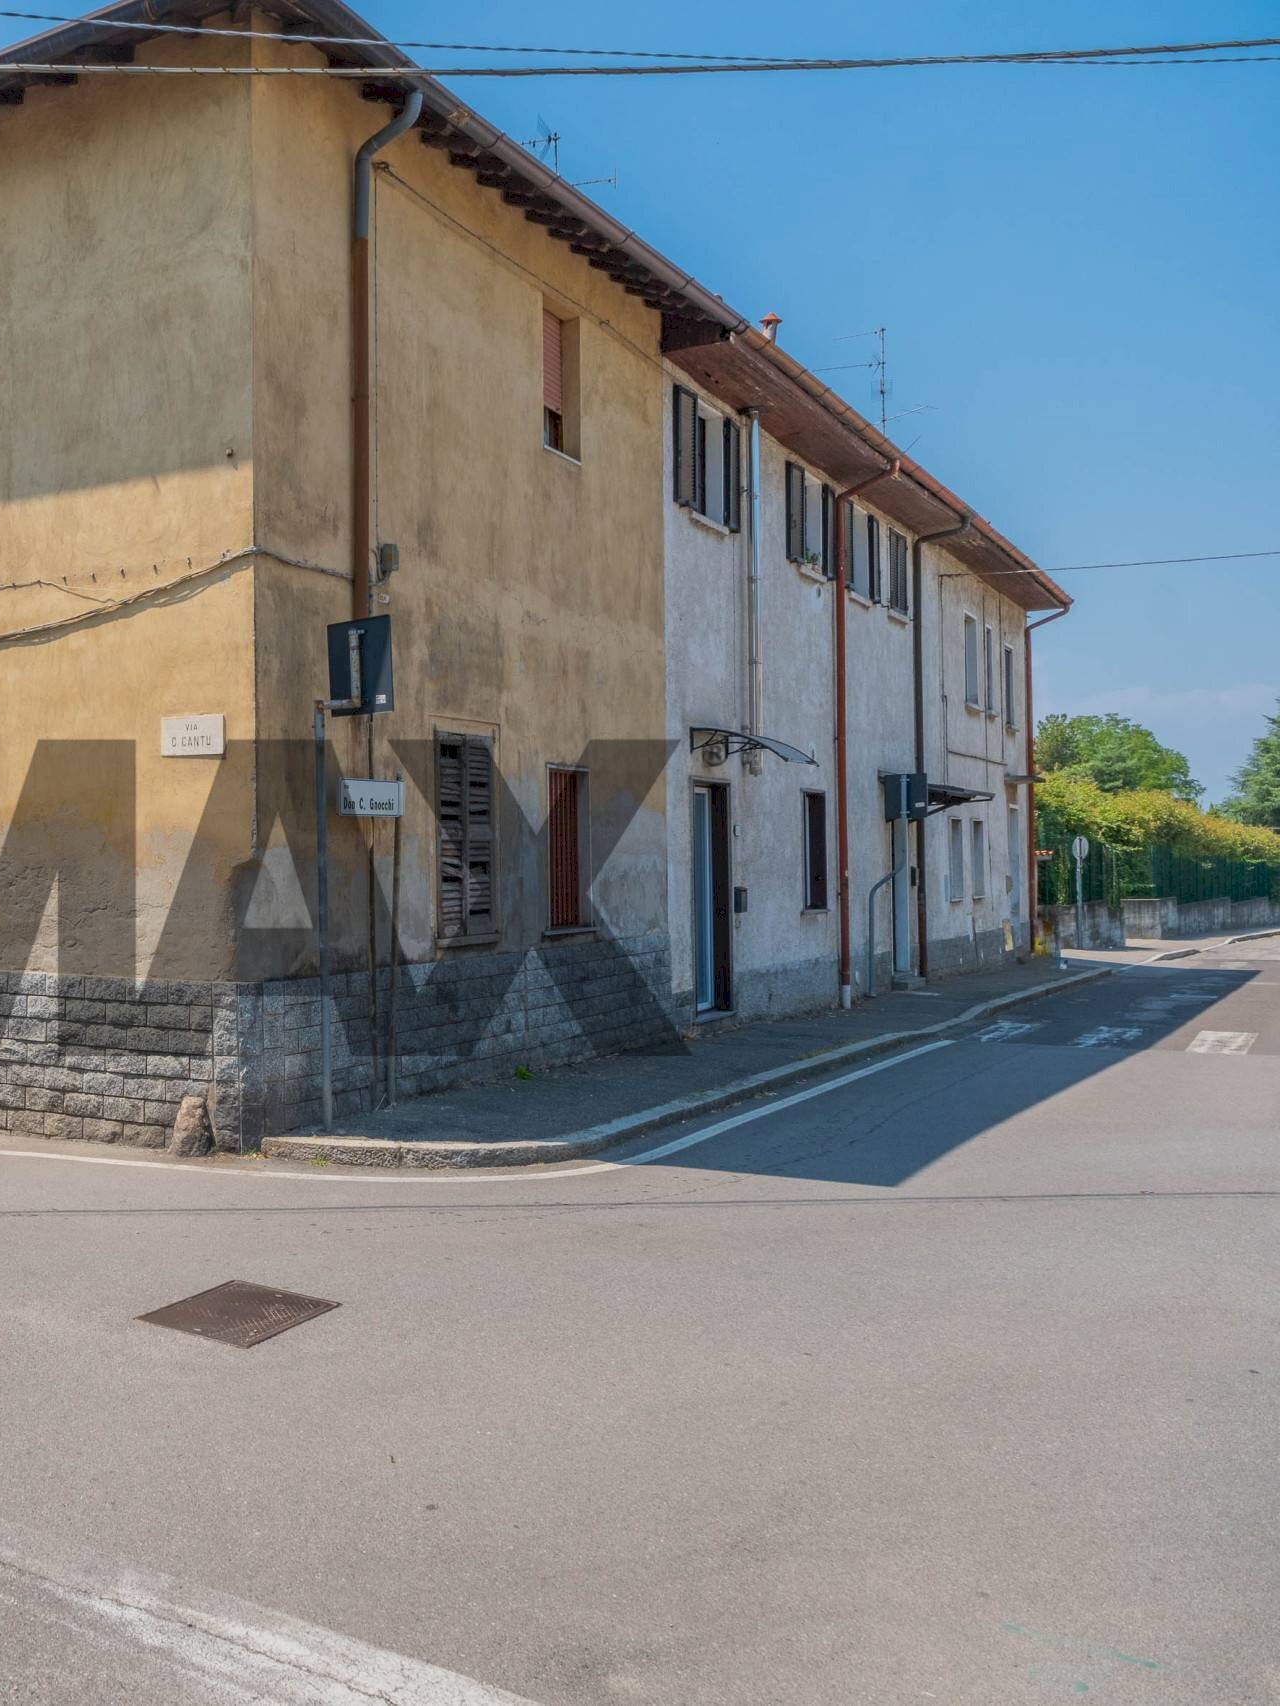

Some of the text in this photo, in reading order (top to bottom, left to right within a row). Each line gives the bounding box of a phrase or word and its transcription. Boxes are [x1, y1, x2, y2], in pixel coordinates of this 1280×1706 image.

[185, 723, 198, 731] VIA
[343, 797, 394, 811] Don C. Gnocchi
